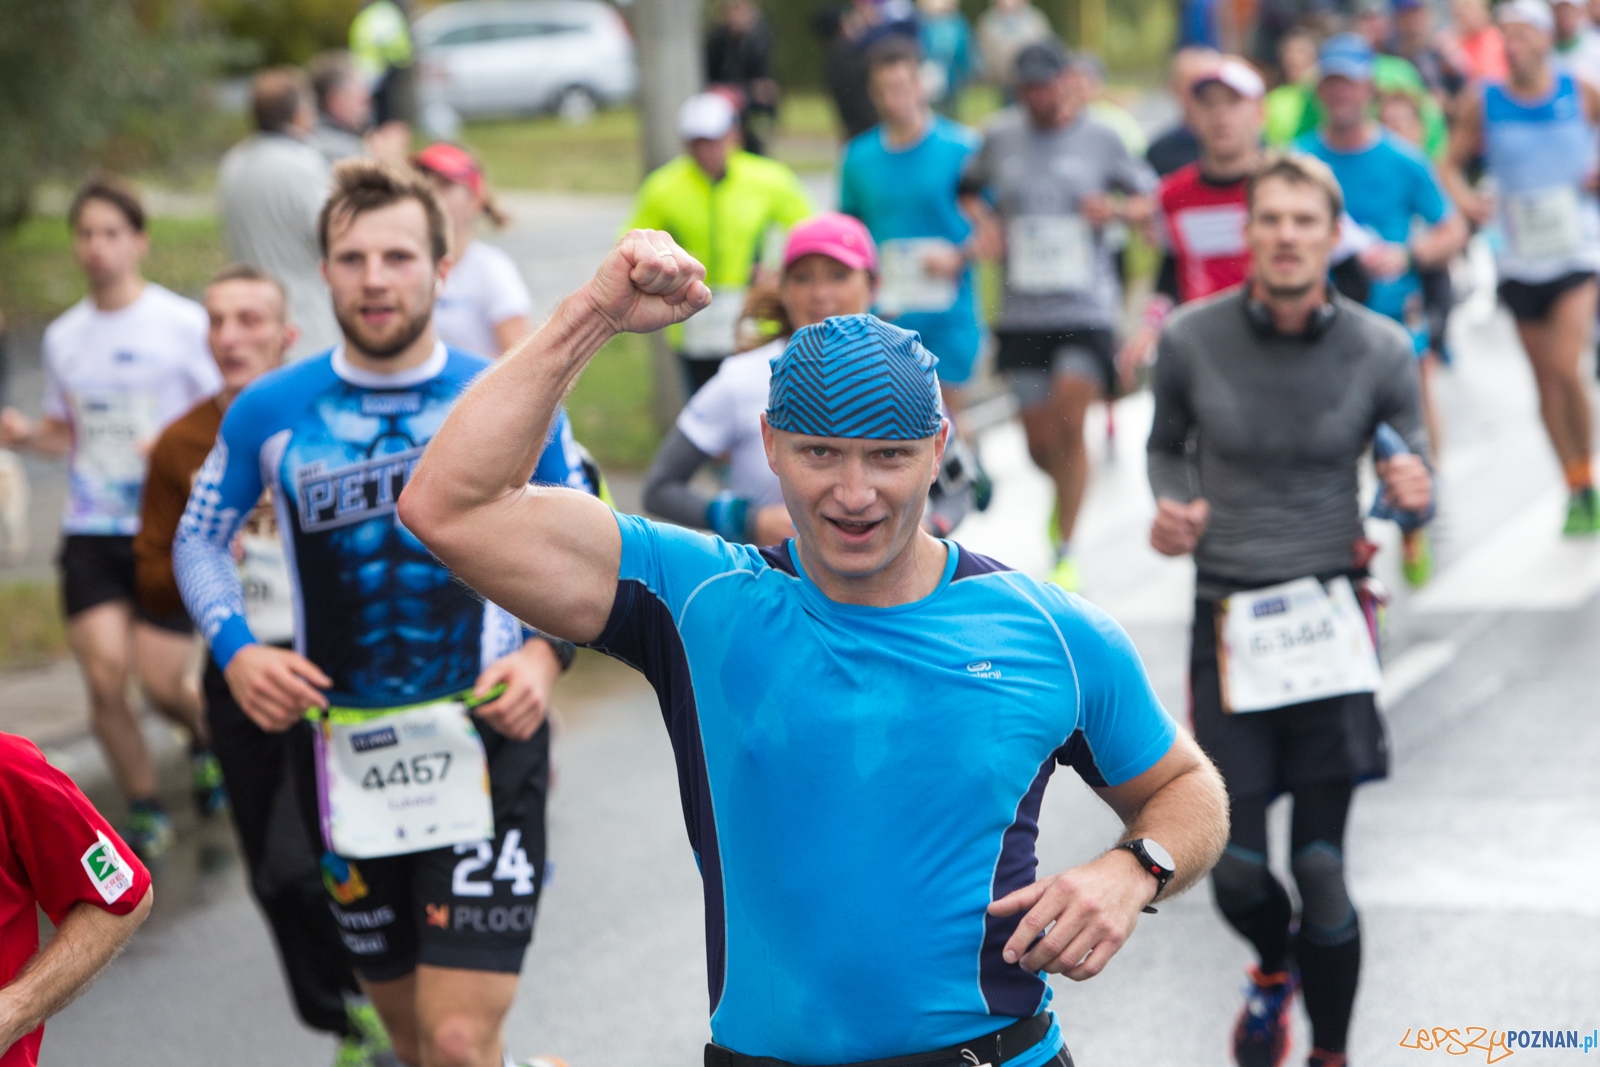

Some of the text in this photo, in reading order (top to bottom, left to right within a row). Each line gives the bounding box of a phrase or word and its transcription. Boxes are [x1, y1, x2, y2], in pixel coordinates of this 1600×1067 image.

[302, 455, 421, 525] PET
[363, 753, 452, 790] 4467
[451, 829, 535, 897] 24
